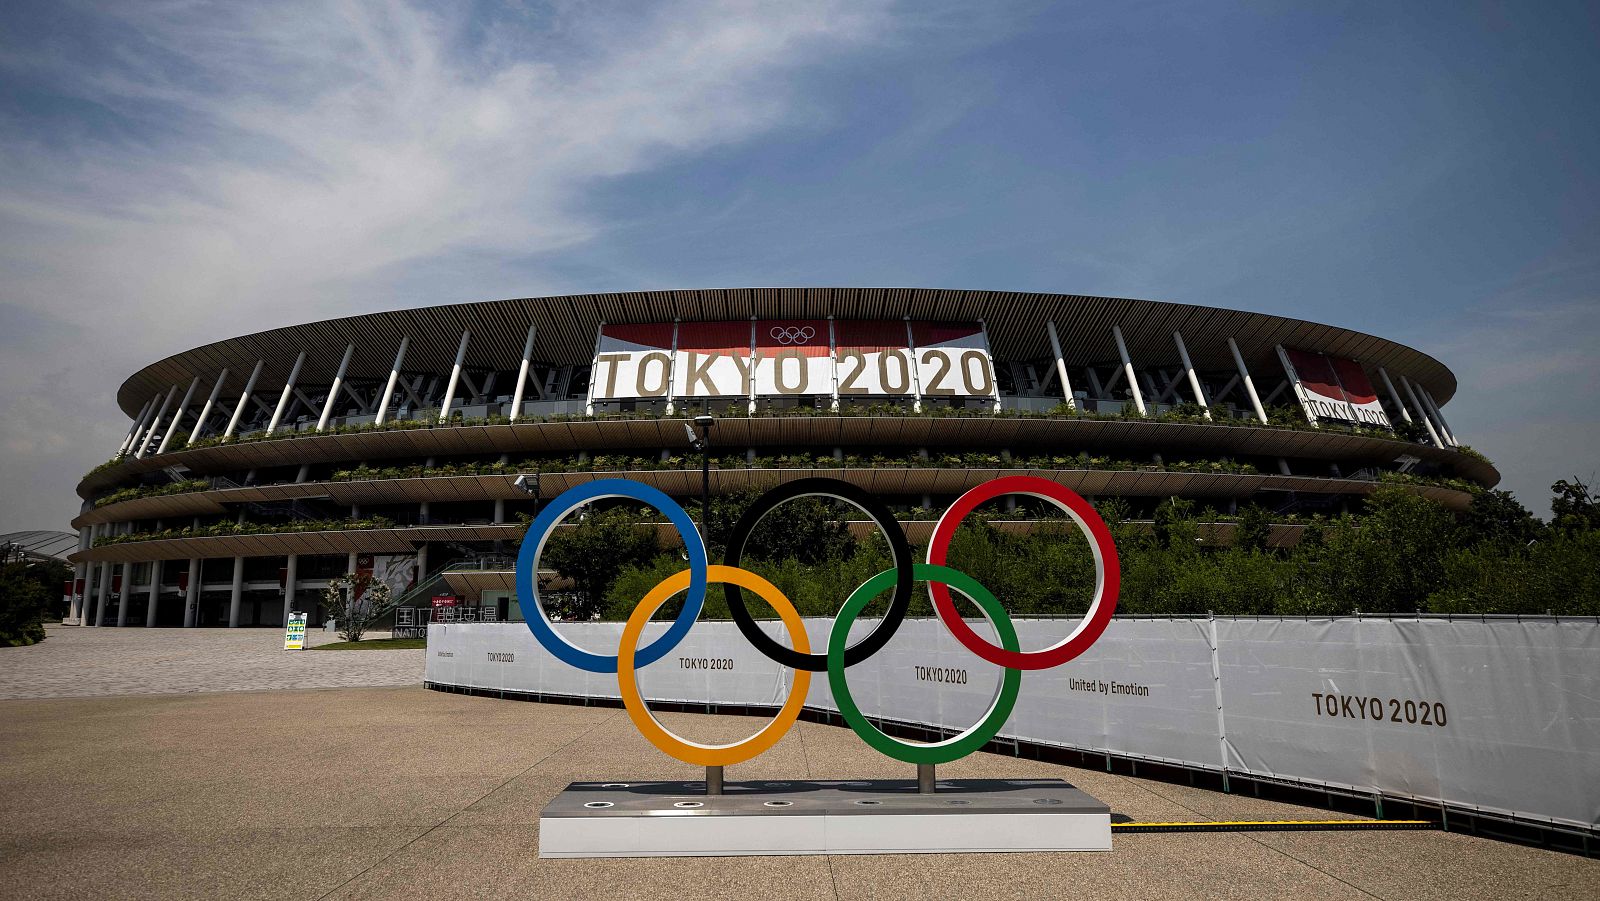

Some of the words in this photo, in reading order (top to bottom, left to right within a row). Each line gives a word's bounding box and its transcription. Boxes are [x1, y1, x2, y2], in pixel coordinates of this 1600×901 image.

[598, 350, 808, 398] TOKYO
[836, 349, 993, 396] 2020
[1307, 400, 1358, 421] TOKYO
[394, 628, 427, 638] NATIO
[487, 652, 502, 662] TOKYO
[502, 652, 515, 663] 2020
[679, 657, 708, 670] TOKYO
[710, 658, 734, 670] 2020
[914, 666, 943, 682] TOKYO
[944, 668, 968, 685] 2020
[1069, 678, 1096, 692] United
[1098, 680, 1109, 695] by
[1111, 681, 1149, 697] Emotion
[1311, 693, 1384, 721] TOKYO
[1388, 698, 1447, 727] 2020
